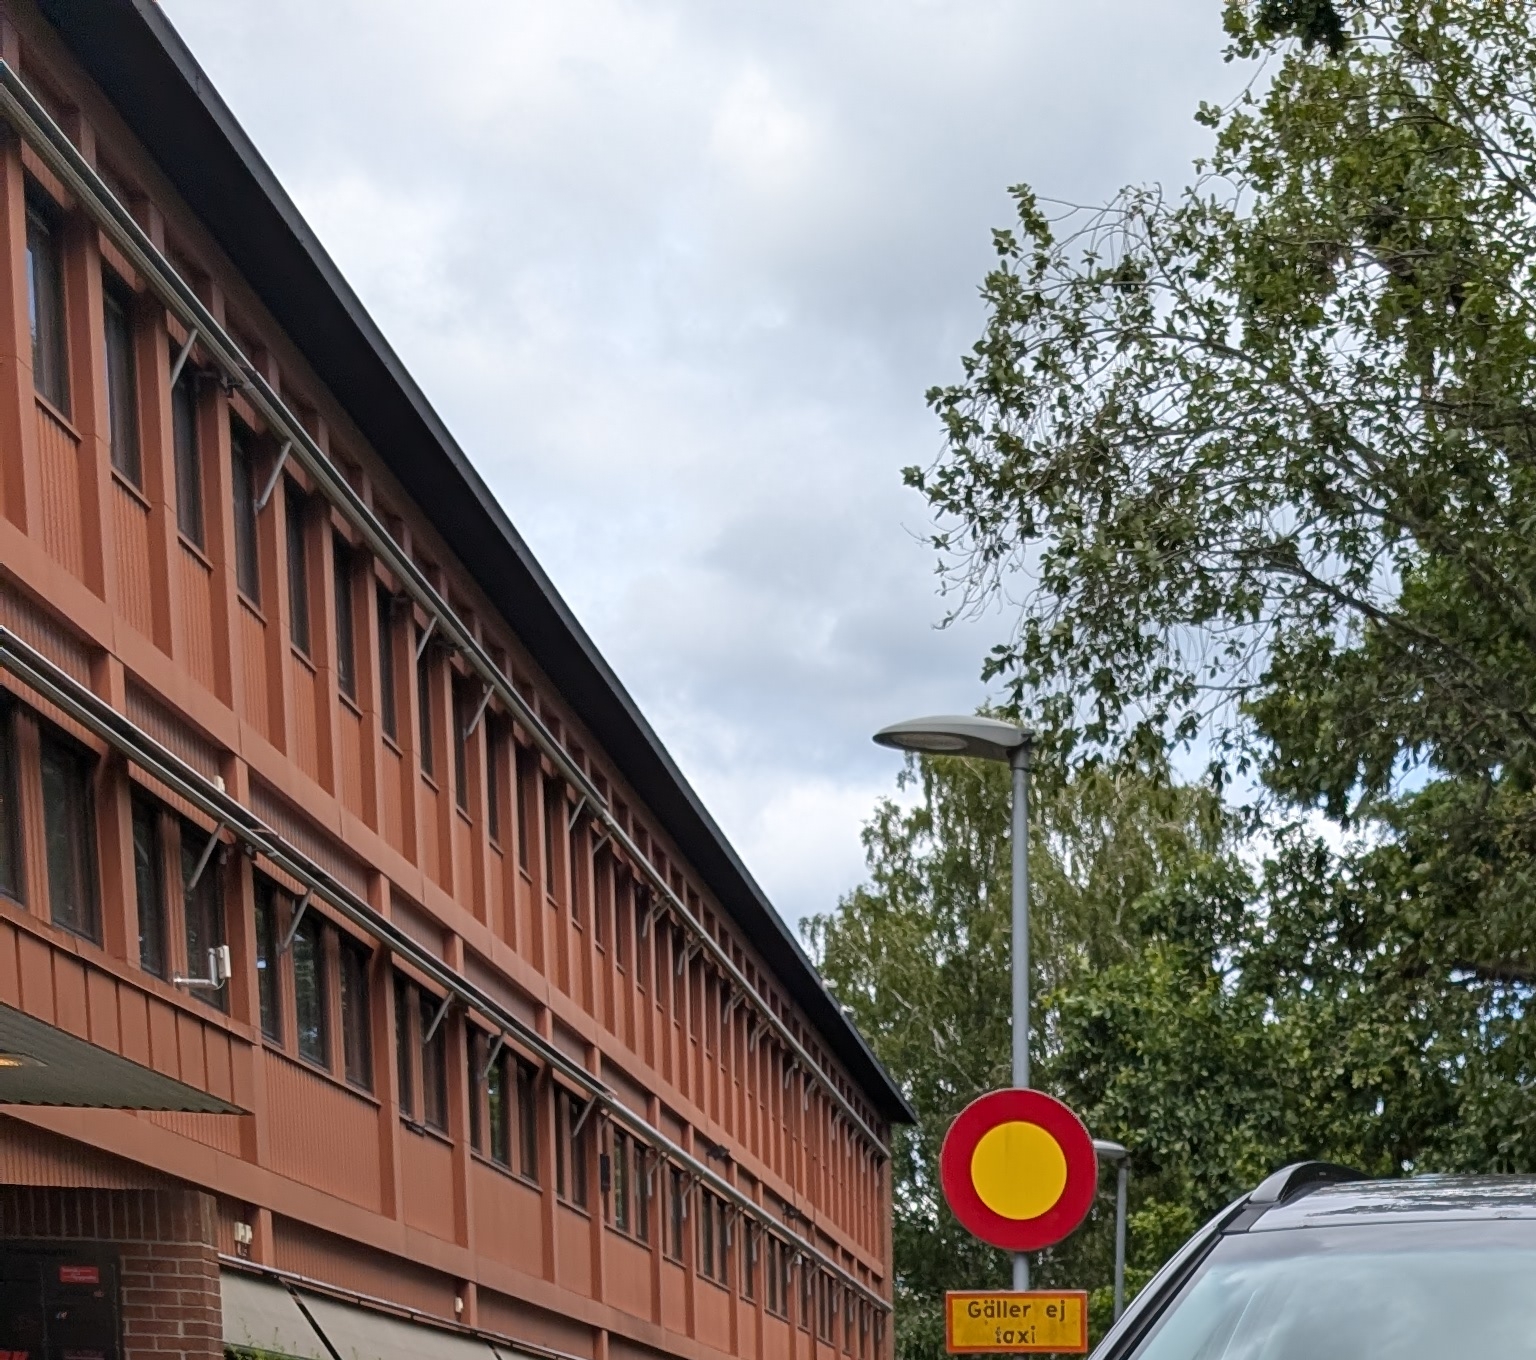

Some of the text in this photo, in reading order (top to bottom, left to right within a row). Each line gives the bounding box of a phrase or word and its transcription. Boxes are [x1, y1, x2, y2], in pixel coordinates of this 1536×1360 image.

[967, 1299, 1066, 1321] Gäller ej
[995, 1326, 1037, 1344] taxi
